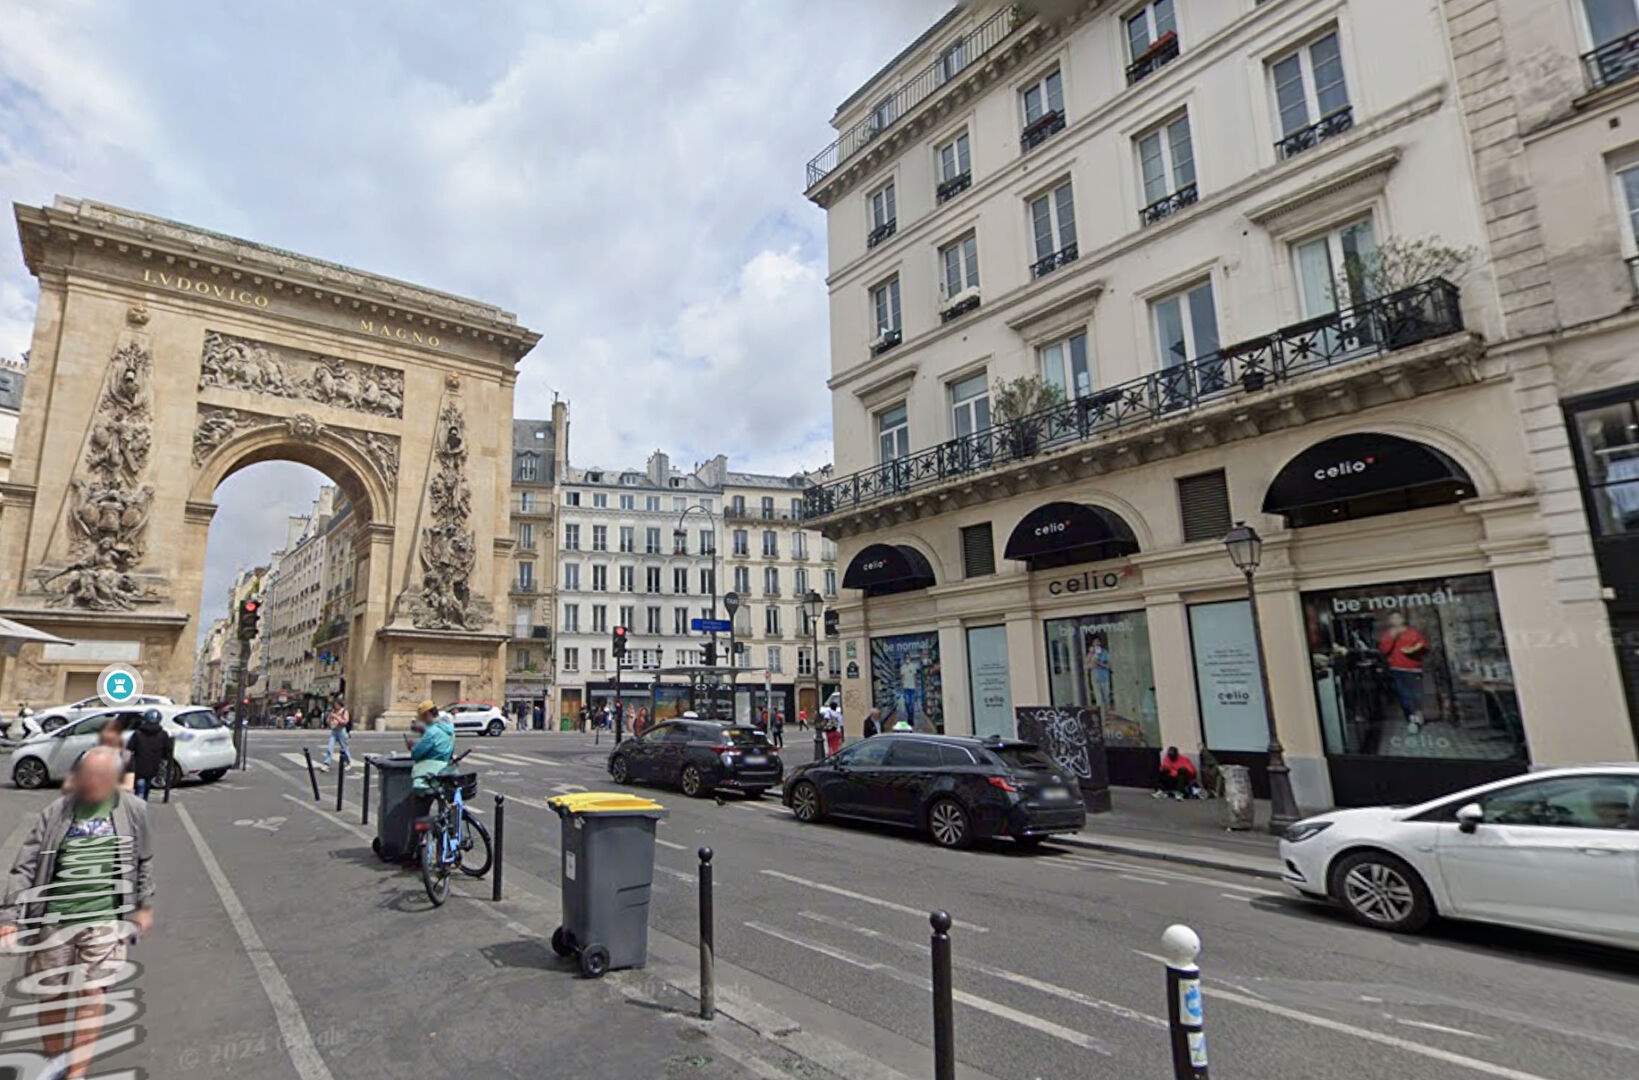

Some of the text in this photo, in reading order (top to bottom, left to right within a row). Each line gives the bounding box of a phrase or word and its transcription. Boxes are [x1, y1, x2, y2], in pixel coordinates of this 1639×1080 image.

[143, 269, 440, 347] LVDOVICO MAGNO
[1314, 460, 1366, 480] celio
[1035, 522, 1065, 537] celio
[863, 560, 884, 571] celio
[1049, 571, 1118, 595] celio
[1332, 586, 1461, 614] be normal.
[1217, 690, 1249, 701] celio
[1390, 734, 1449, 749] celio
